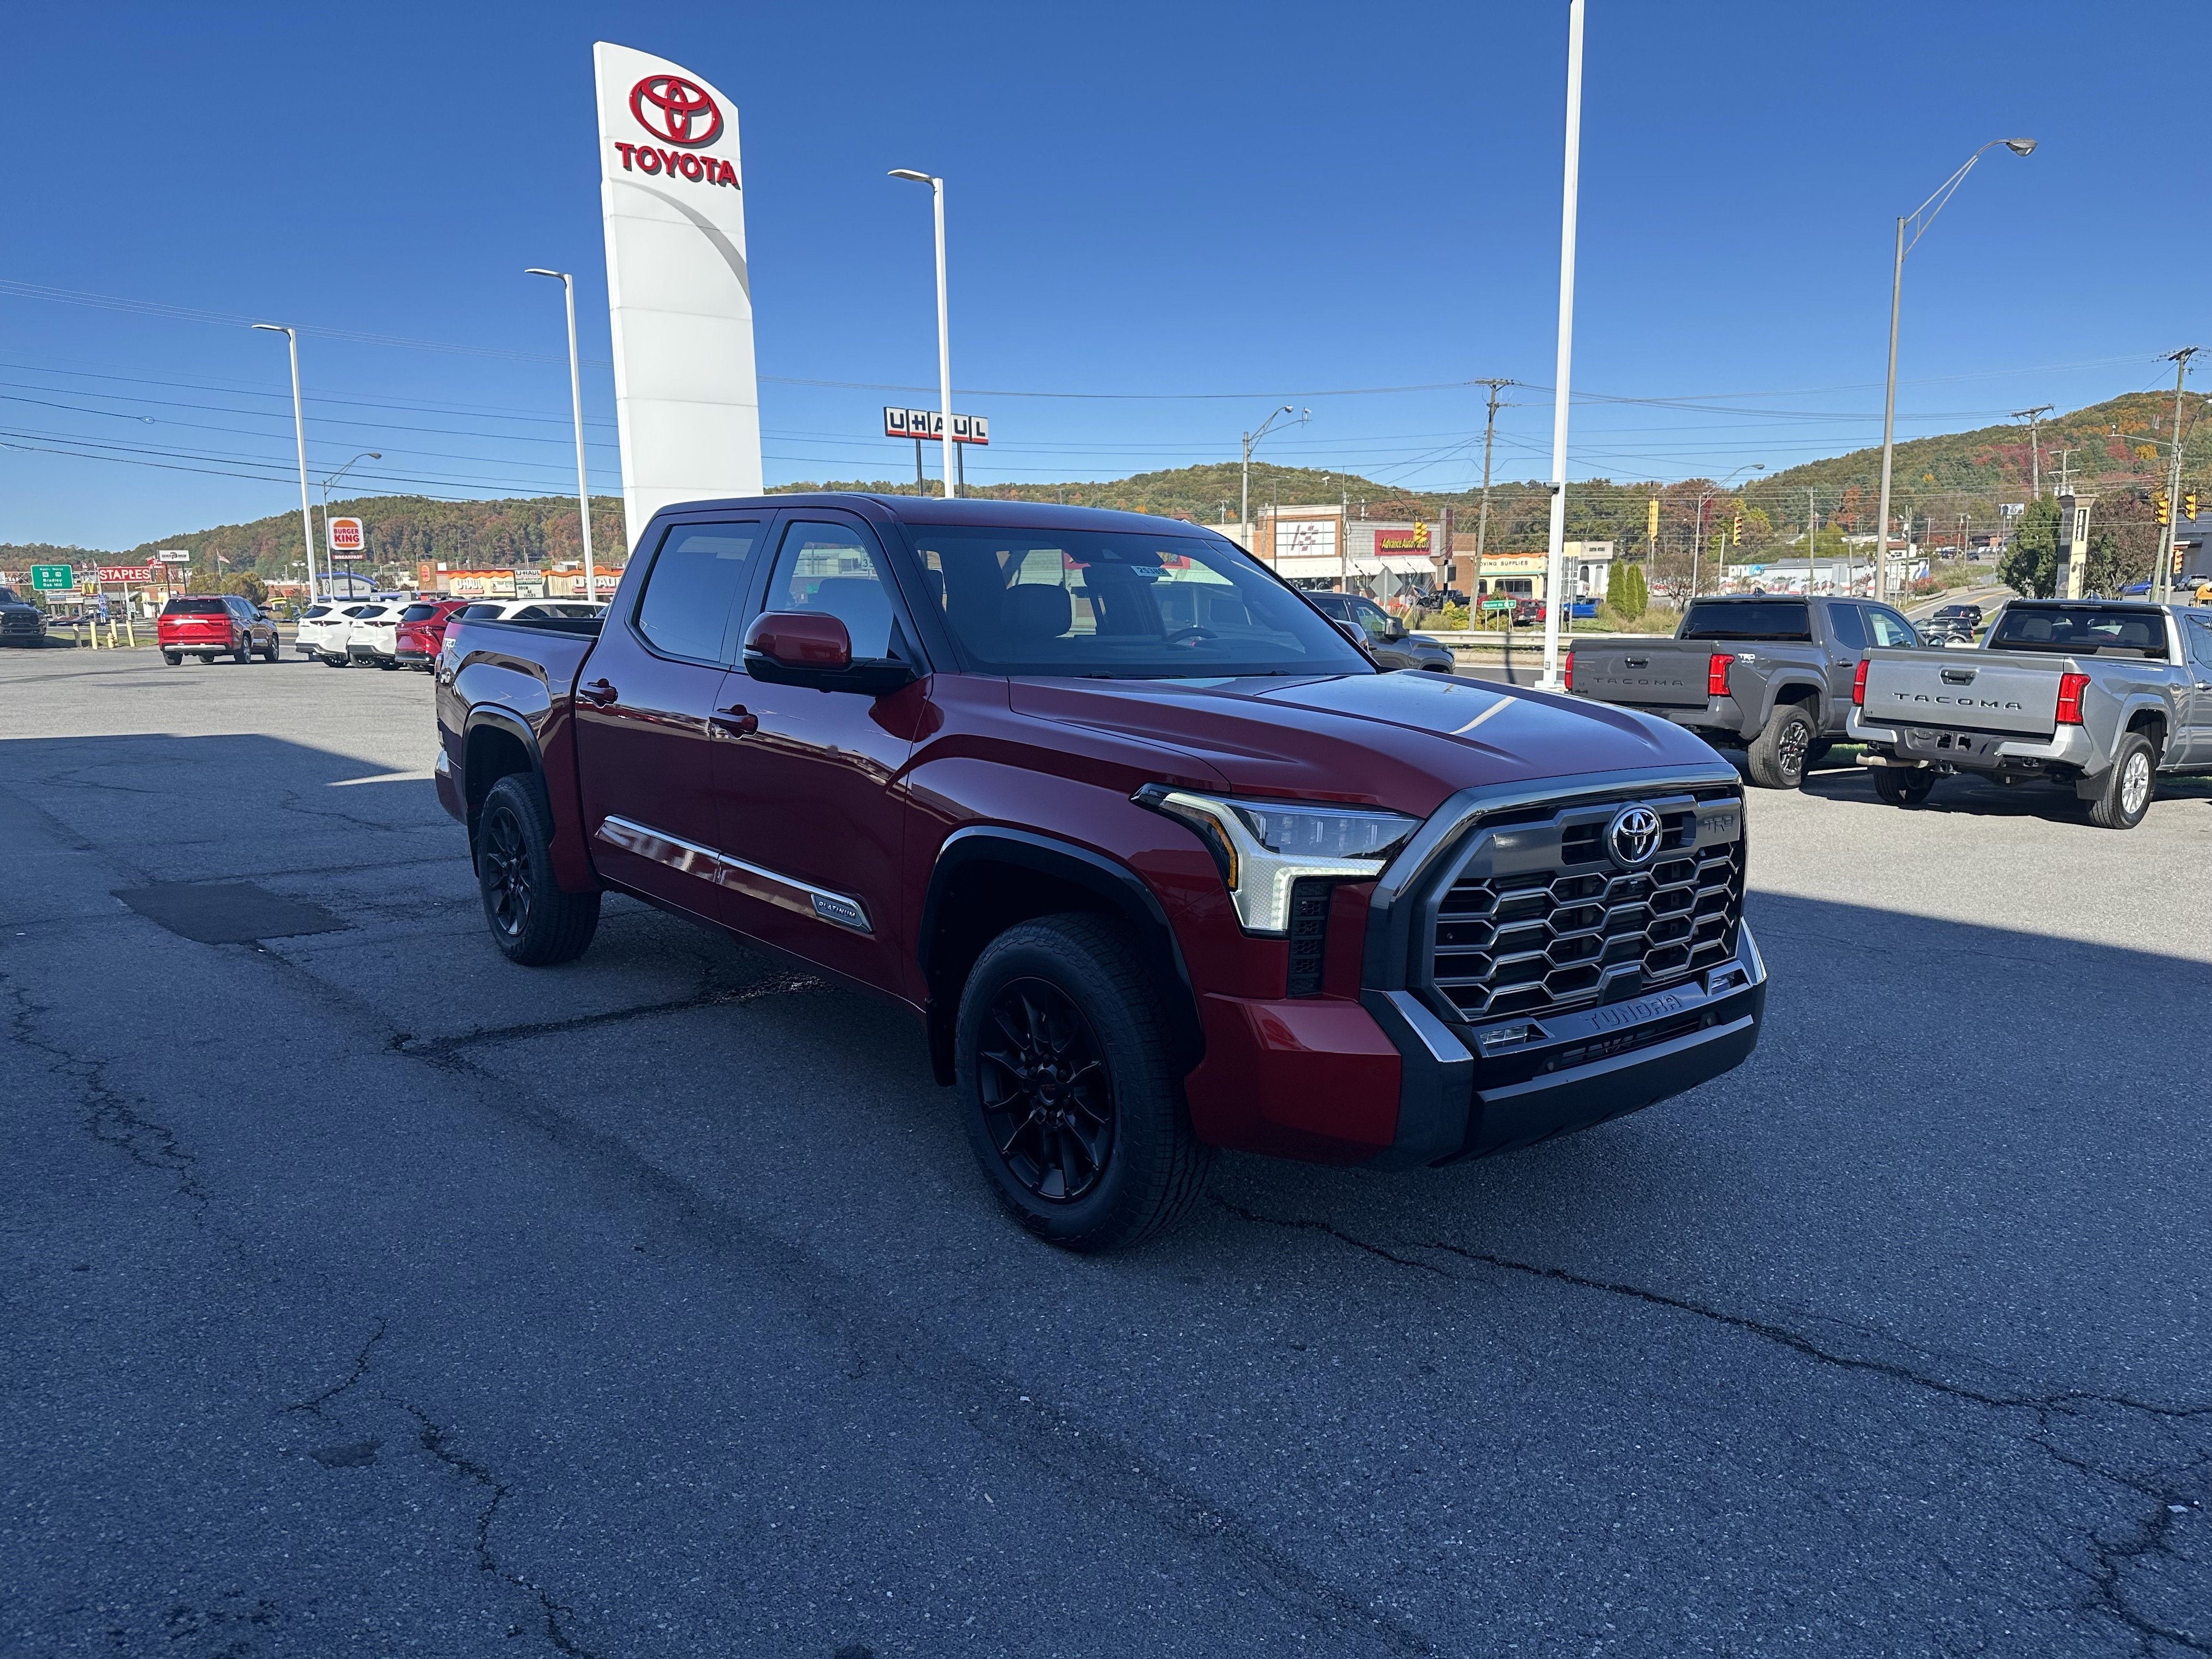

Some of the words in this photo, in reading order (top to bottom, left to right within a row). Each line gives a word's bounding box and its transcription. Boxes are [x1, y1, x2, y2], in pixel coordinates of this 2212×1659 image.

[614, 142, 737, 186] TOYOTA
[1381, 538, 1402, 548] Advance
[1402, 538, 1414, 548] Auto
[99, 569, 150, 580] STAPLES
[444, 637, 456, 650] TRD
[1593, 678, 1684, 686] TACOMA
[1892, 692, 2022, 710] TACOMA
[1703, 815, 1734, 833] TRD
[818, 900, 856, 918] PLATINUM
[1583, 994, 1683, 1030] TUNDRA
